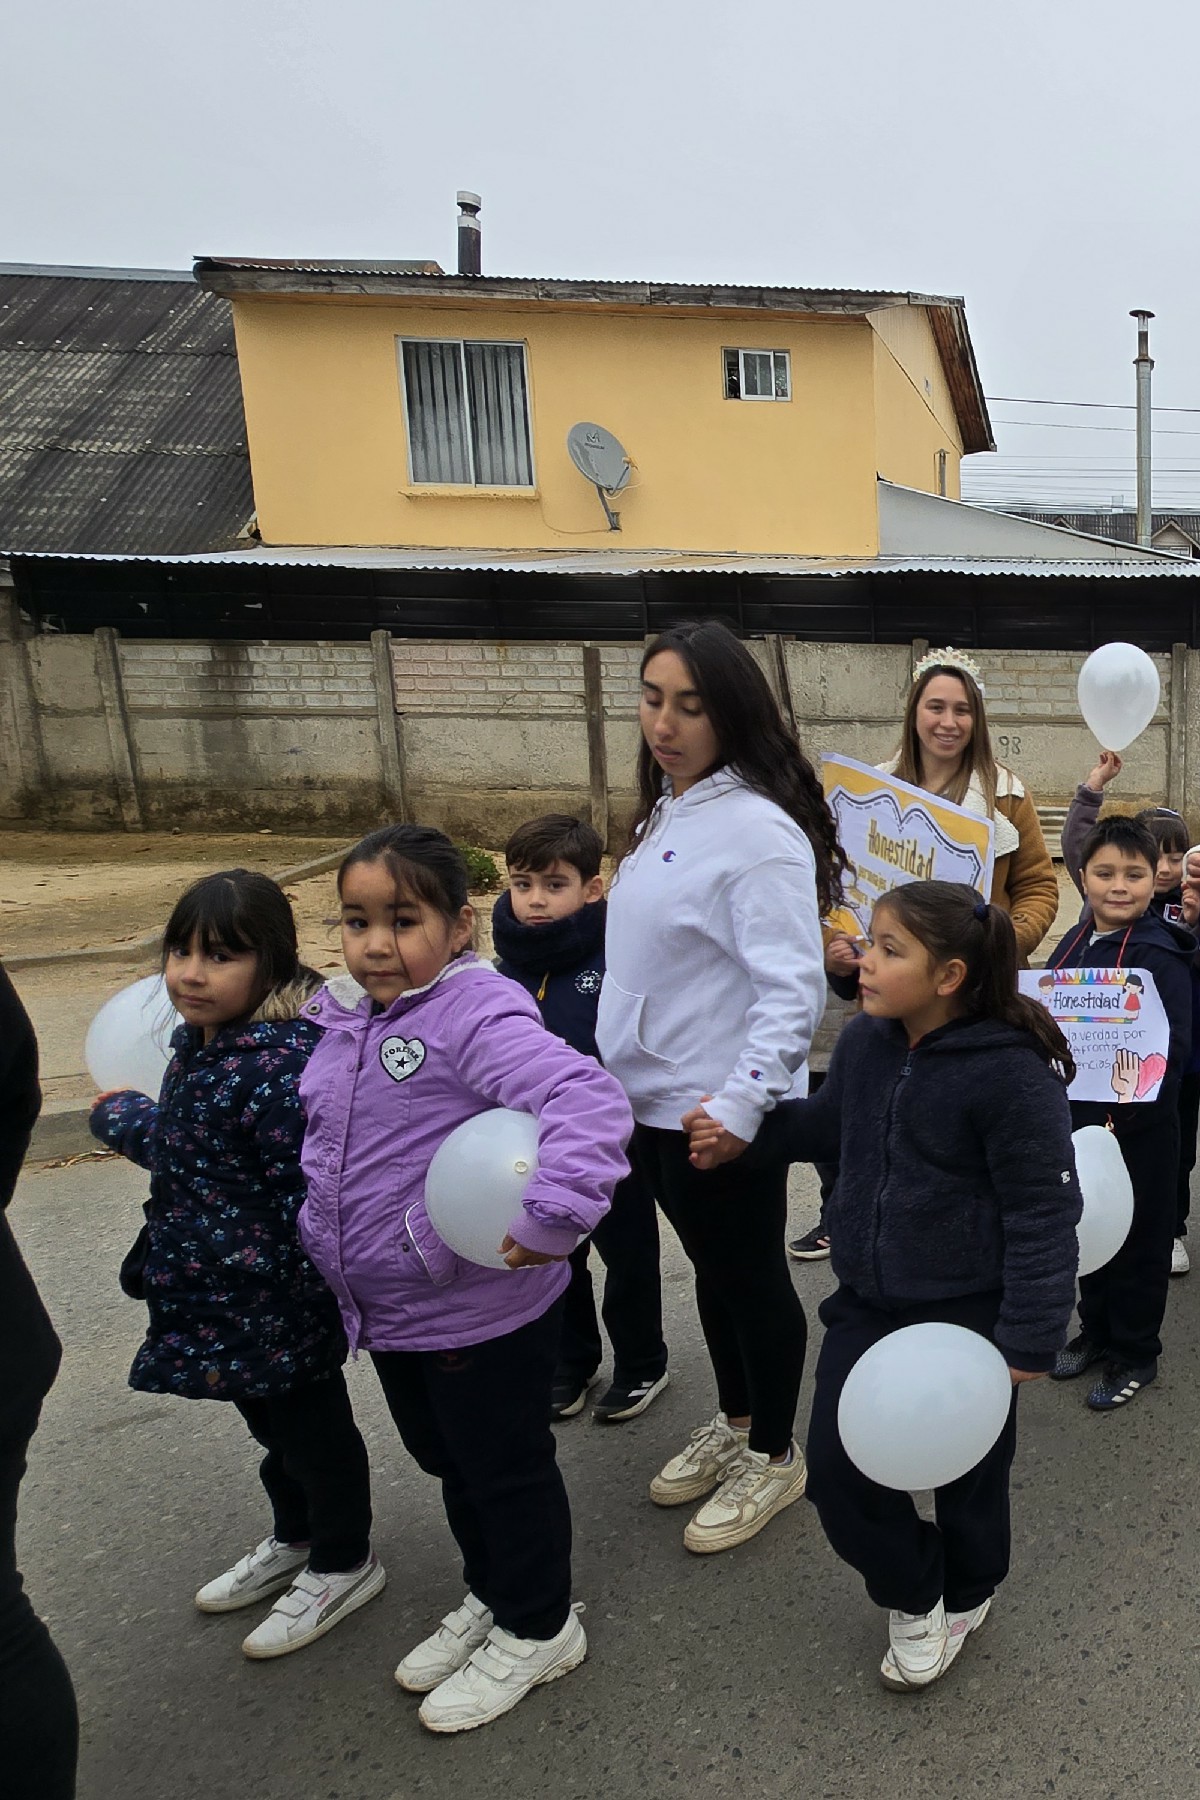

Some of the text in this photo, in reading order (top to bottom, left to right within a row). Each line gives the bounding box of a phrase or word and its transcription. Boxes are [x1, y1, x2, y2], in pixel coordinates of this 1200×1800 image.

[868, 819, 934, 880] Honestidad
[1053, 991, 1121, 1010] Honestidad
[1080, 1028, 1119, 1041] verdad
[1123, 1029, 1146, 1043] por
